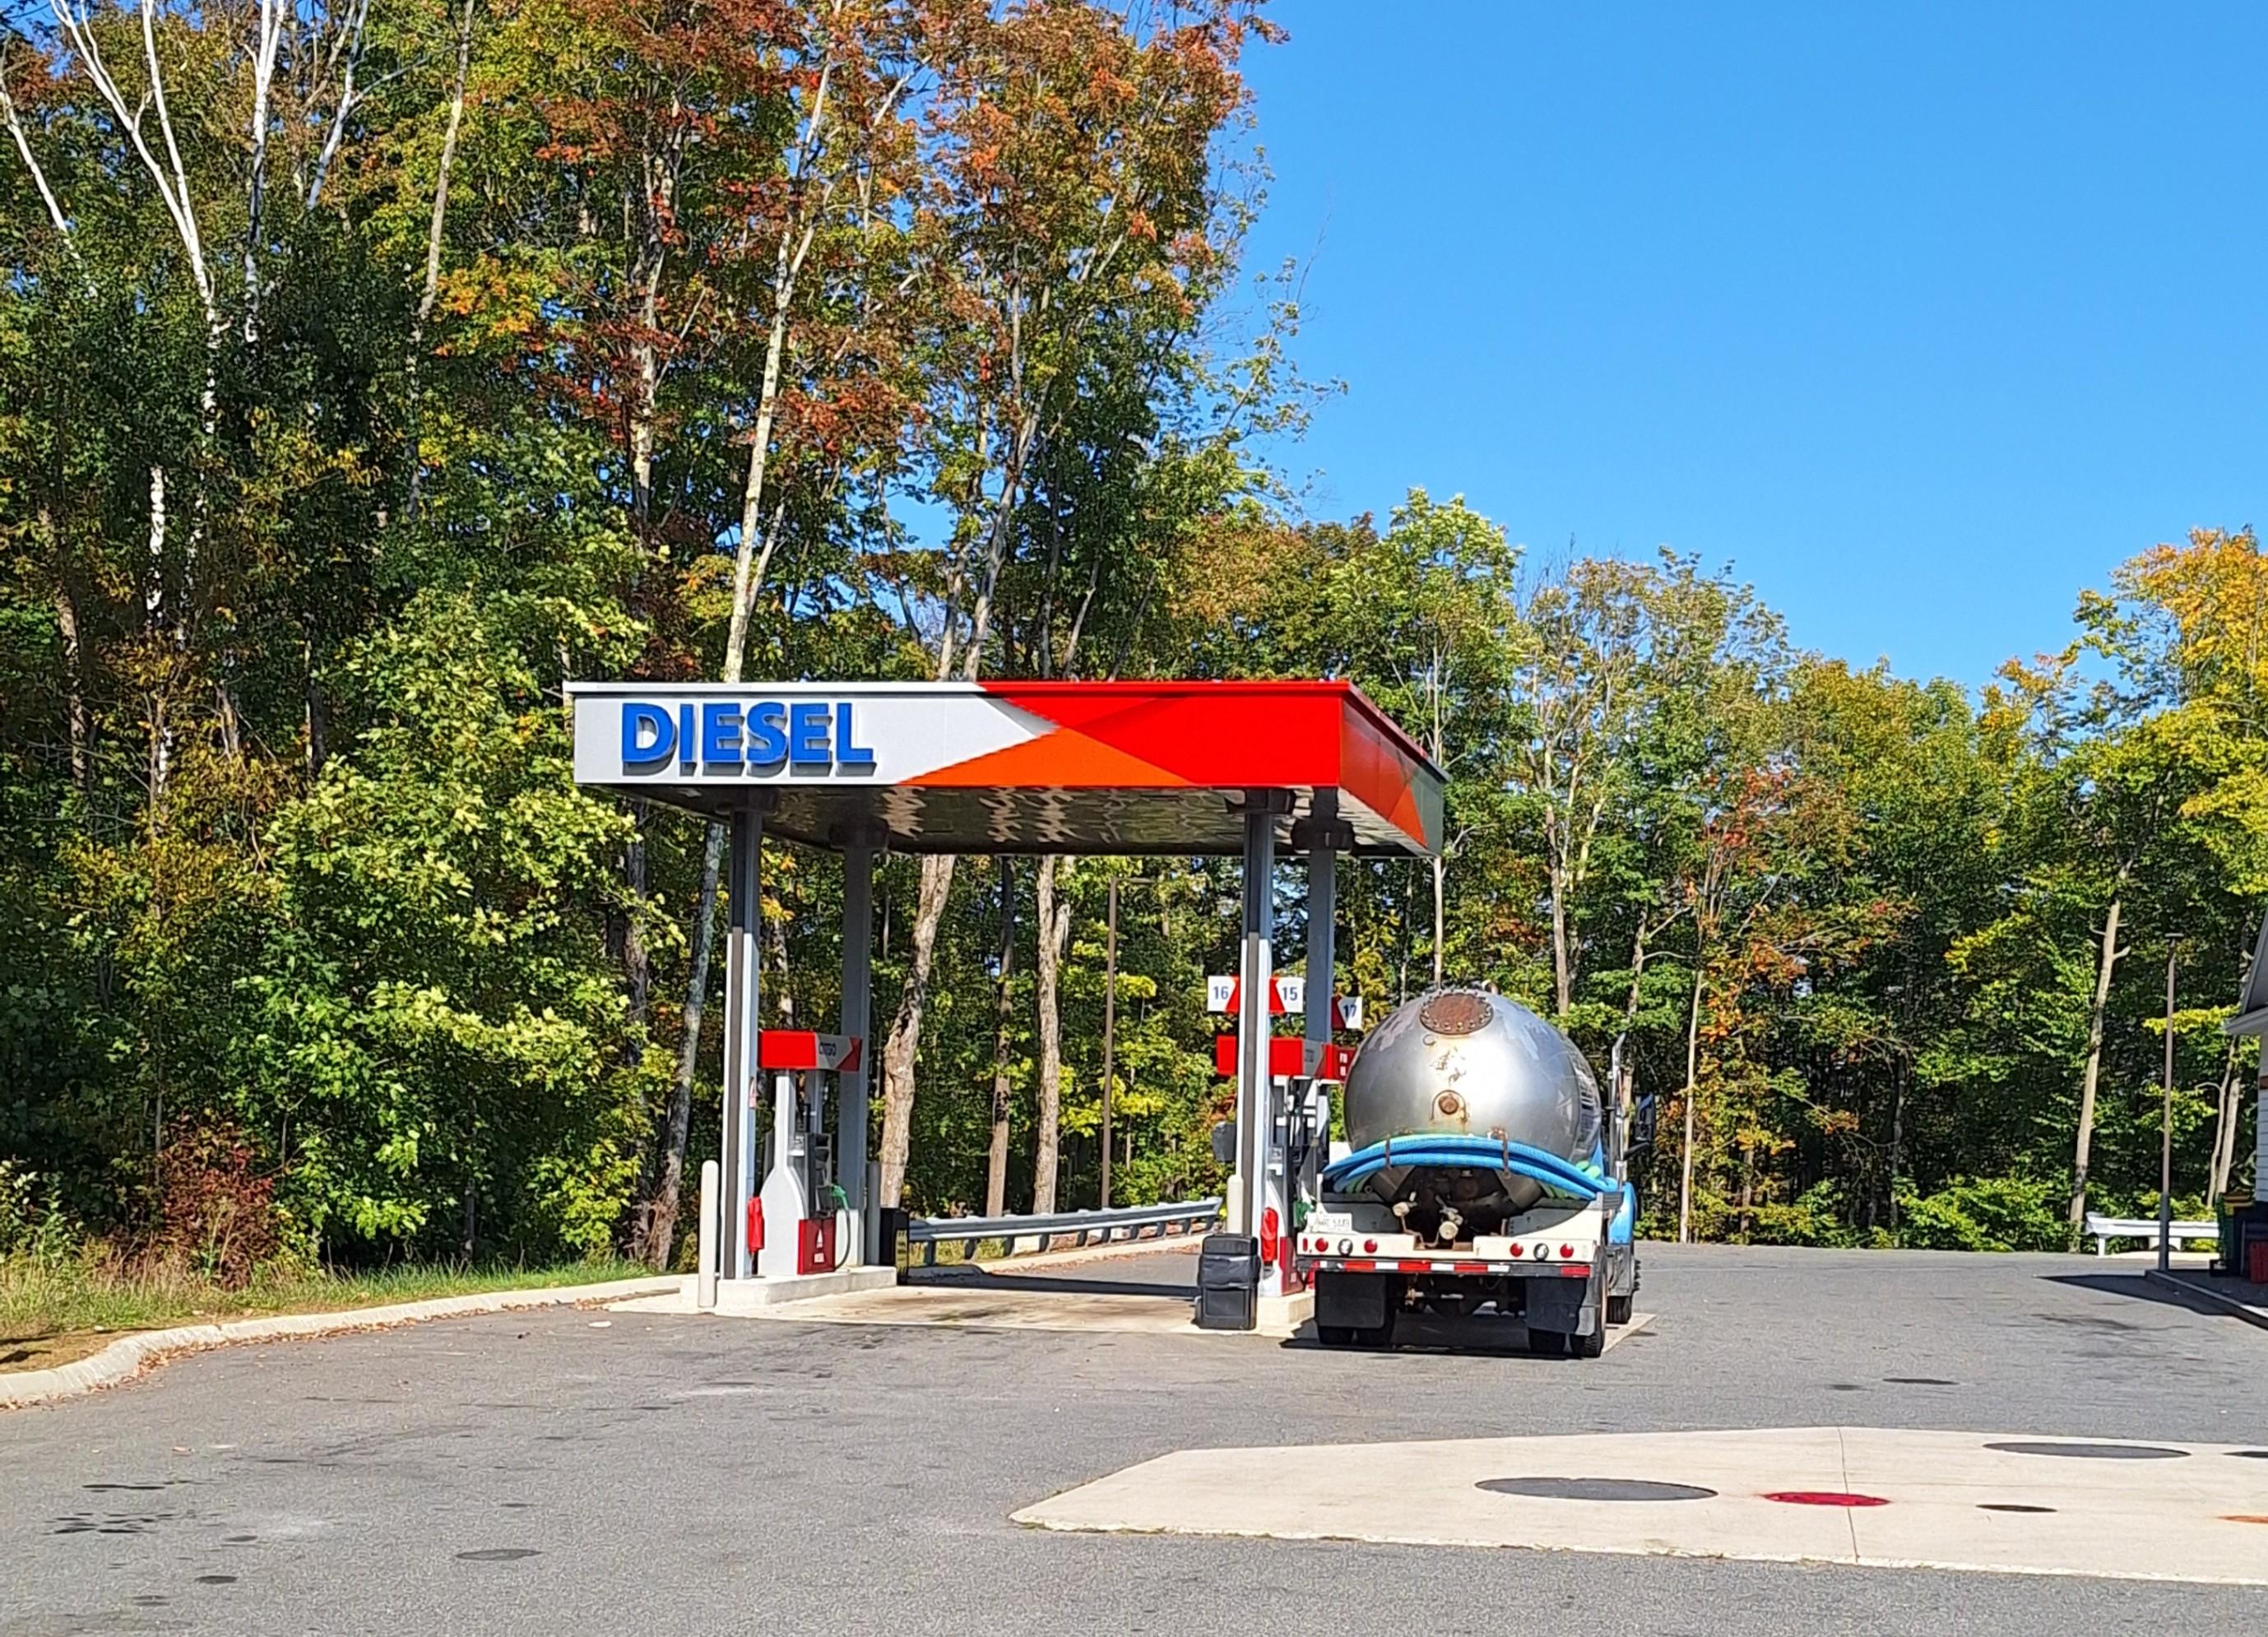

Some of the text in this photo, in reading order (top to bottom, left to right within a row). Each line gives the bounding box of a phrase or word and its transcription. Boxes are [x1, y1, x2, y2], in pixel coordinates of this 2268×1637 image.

[622, 702, 874, 769] DIESEL
[1213, 986, 1229, 999] 16
[1282, 987, 1298, 1001] 15
[1343, 1004, 1357, 1018] 17
